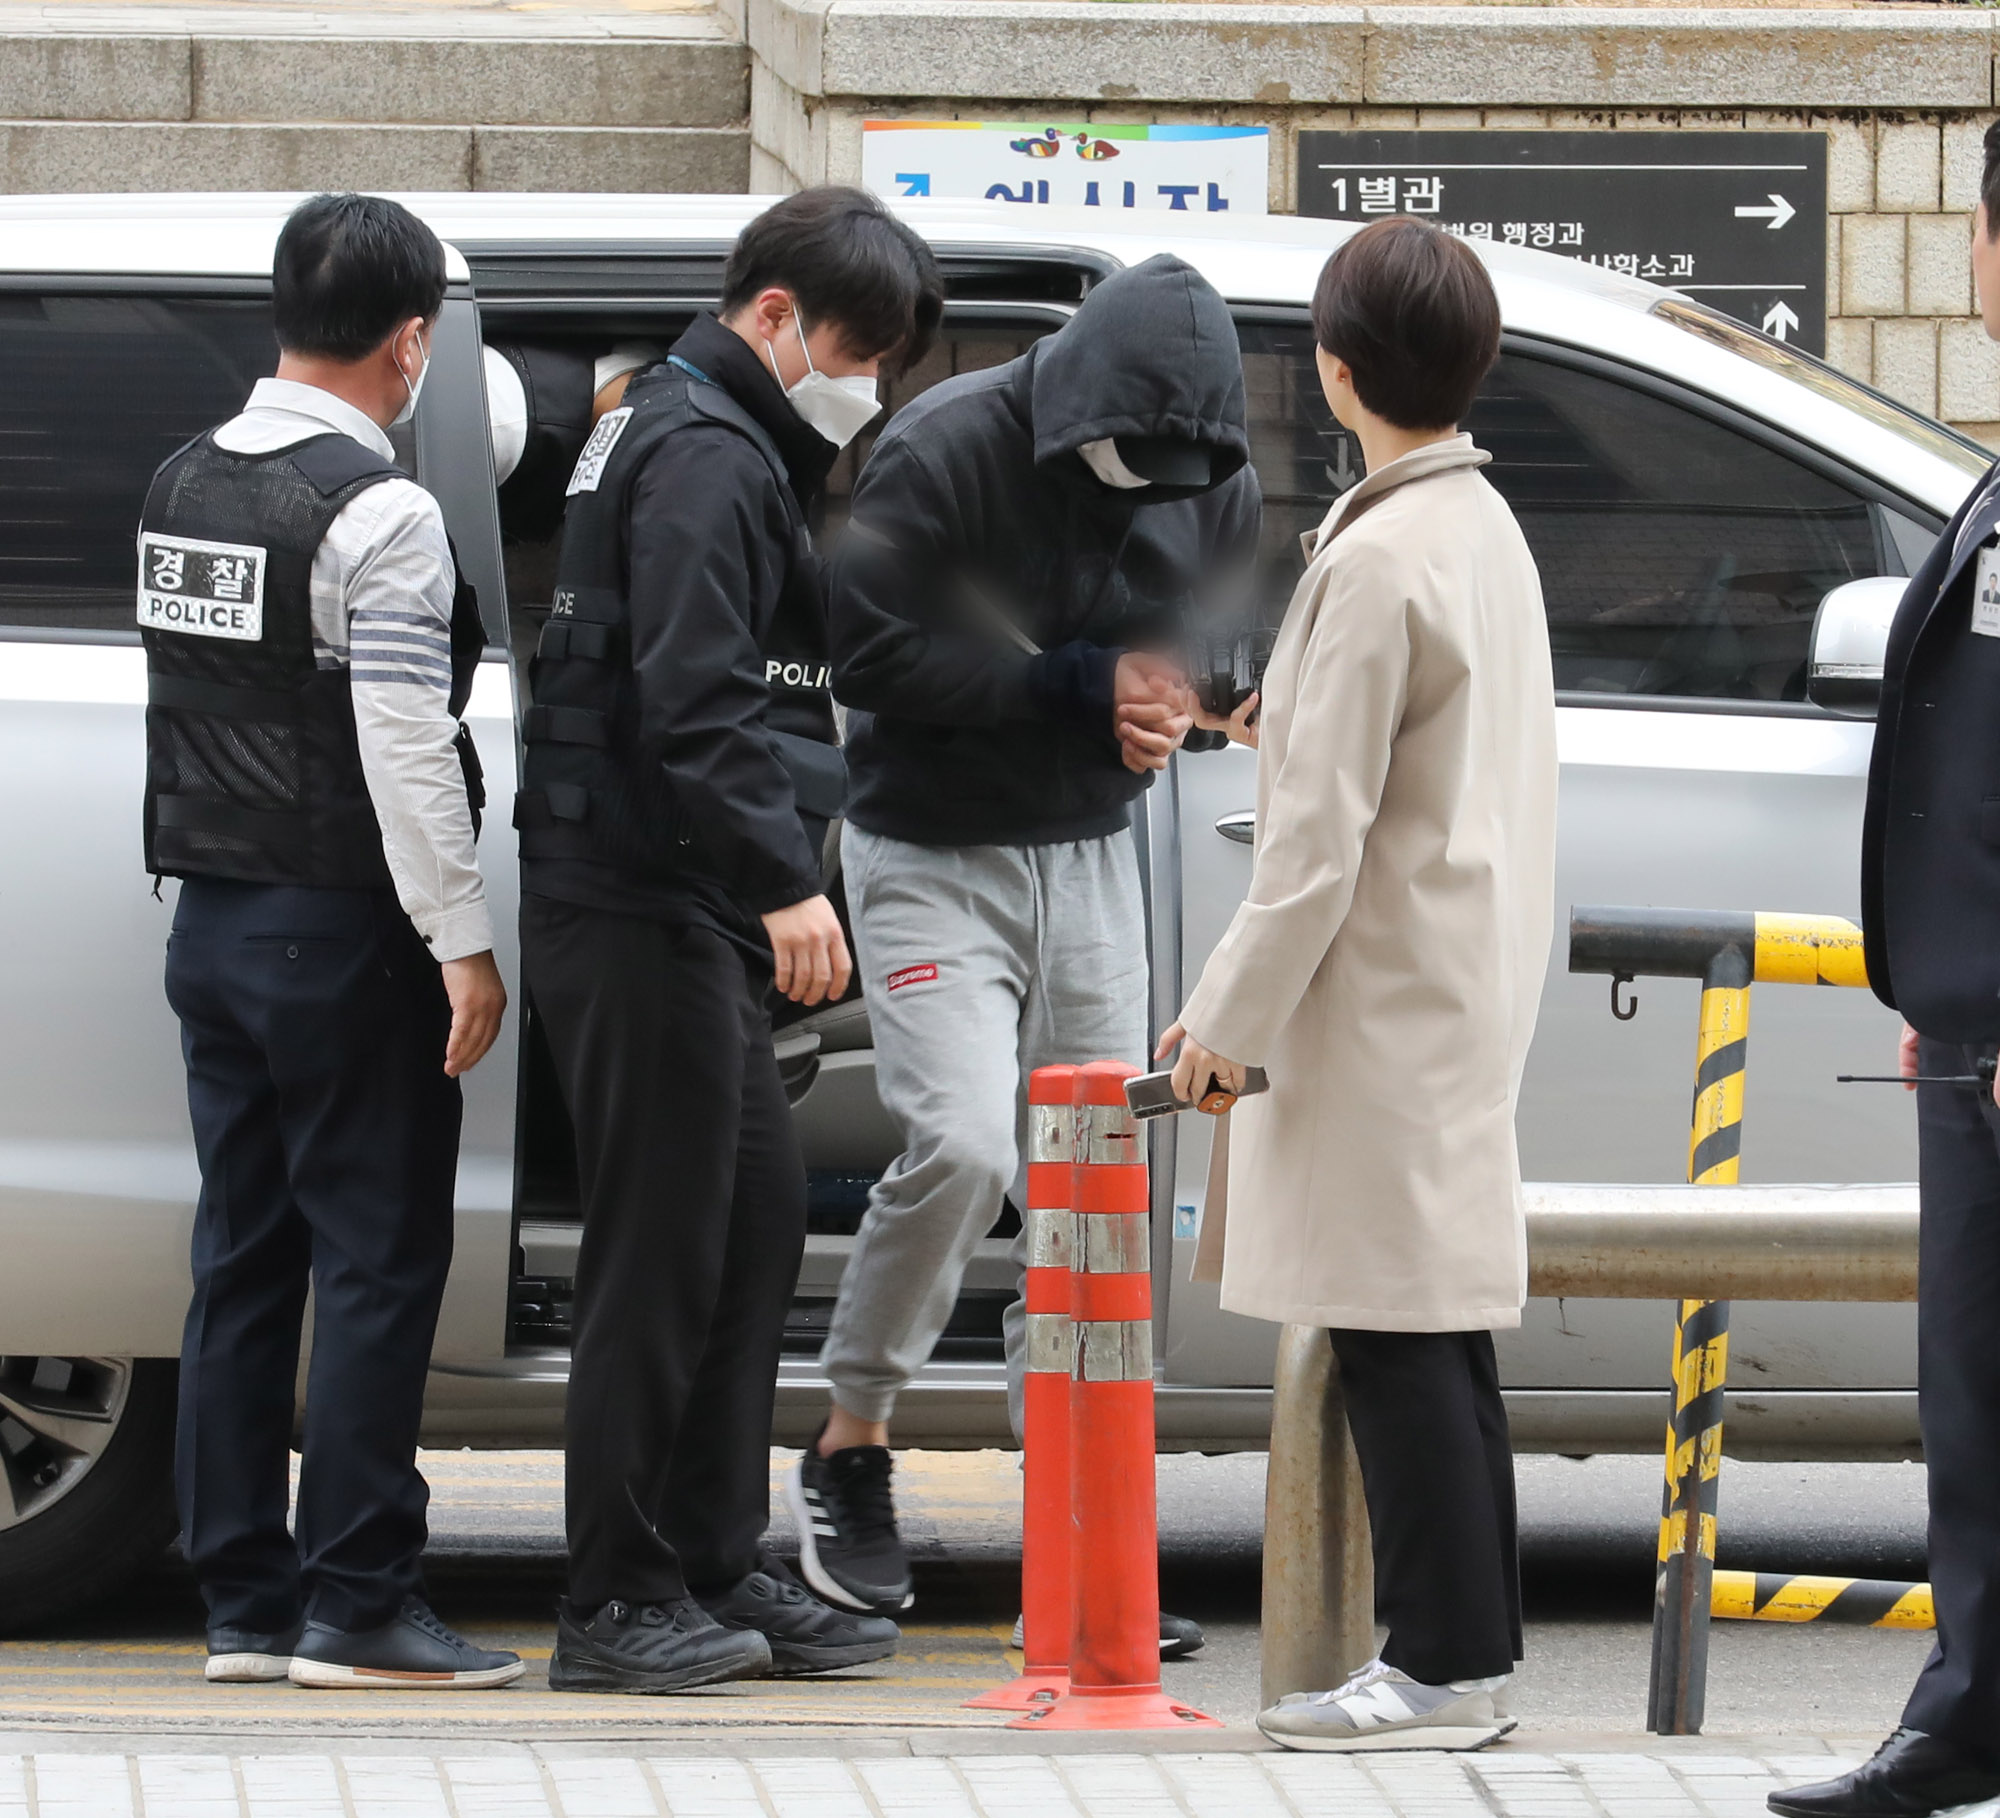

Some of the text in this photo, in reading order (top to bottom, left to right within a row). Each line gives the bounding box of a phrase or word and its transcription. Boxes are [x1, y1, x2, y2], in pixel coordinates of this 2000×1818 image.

[1331, 176, 1445, 213] 1별관
[1502, 222, 1585, 248] 행정과
[150, 598, 244, 629] POLICE
